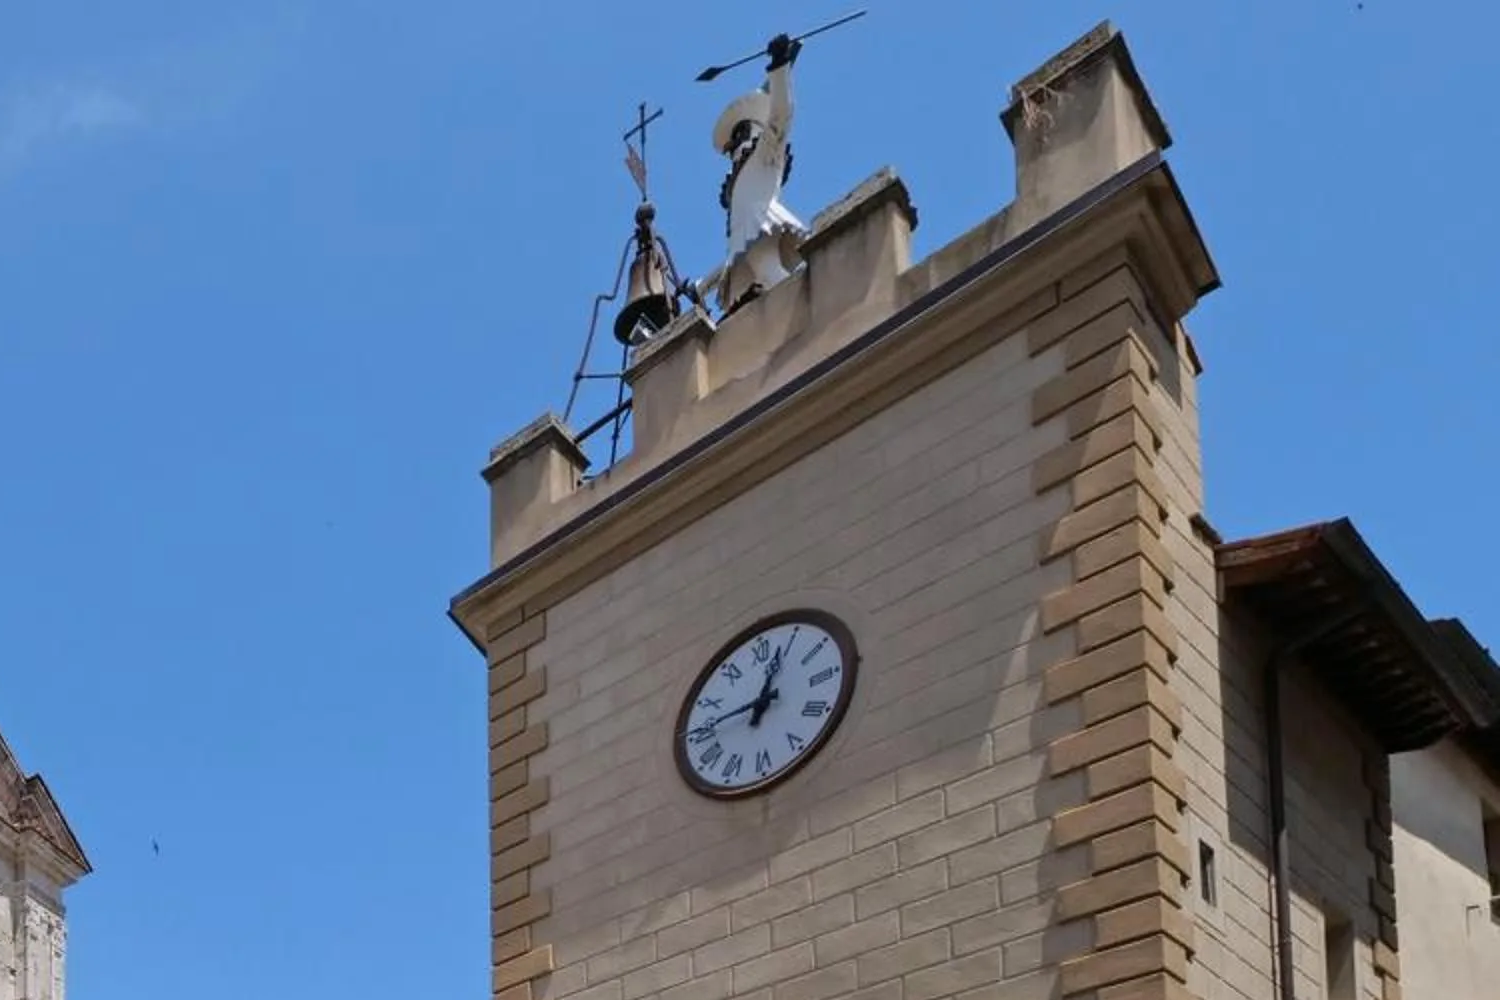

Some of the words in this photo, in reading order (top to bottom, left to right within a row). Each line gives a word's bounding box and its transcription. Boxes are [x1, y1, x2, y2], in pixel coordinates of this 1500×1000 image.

[752, 639, 769, 665] XII
[721, 663, 743, 687] XI
[702, 698, 723, 710] X
[786, 732, 804, 751] V
[755, 750, 772, 773] VI
